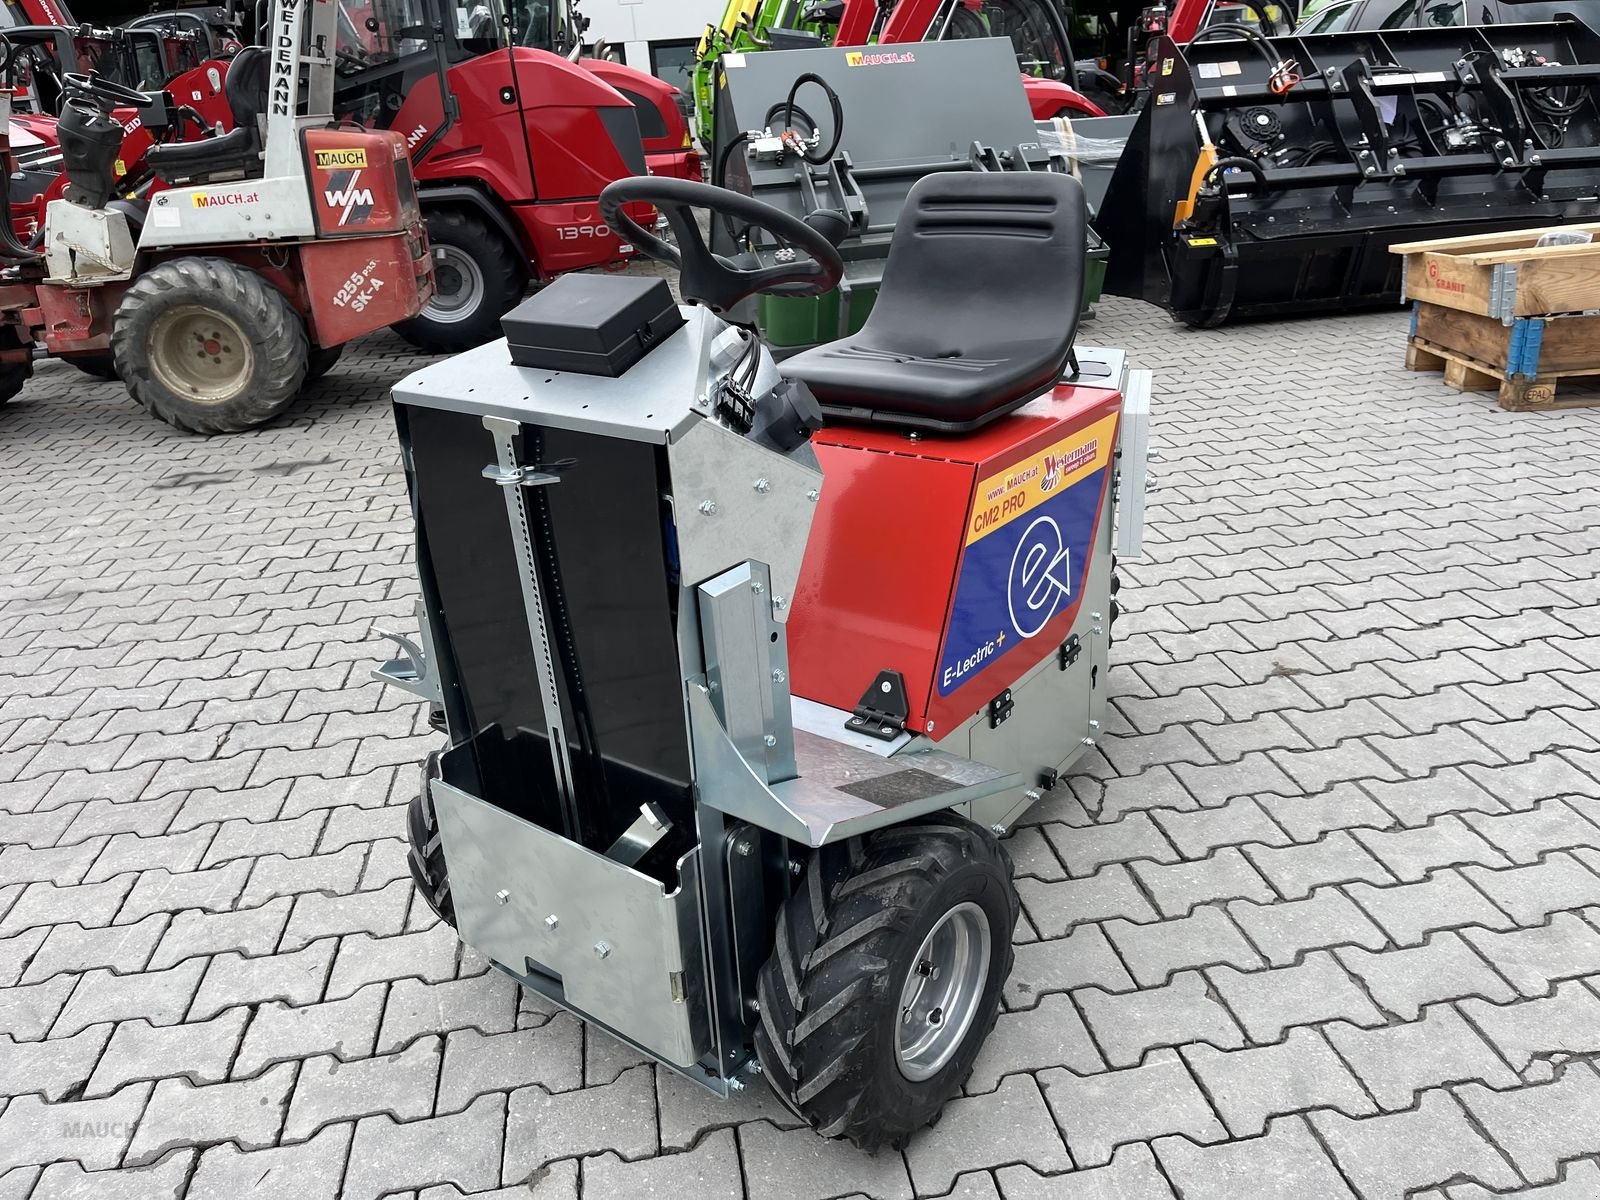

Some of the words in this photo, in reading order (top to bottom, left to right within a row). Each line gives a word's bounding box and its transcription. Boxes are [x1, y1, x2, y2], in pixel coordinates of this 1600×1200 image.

[273, 0, 299, 116] WEIDEMANN
[852, 52, 914, 65] MAUCH.at
[318, 152, 364, 167] MAUCH
[197, 193, 260, 208] MAUCH.at
[556, 224, 611, 240] 1390
[333, 272, 364, 307] 1255
[351, 278, 384, 312] SK-A
[1436, 279, 1465, 293] GRANIT
[1527, 390, 1546, 400] EPAL
[1043, 440, 1097, 478] Westermann
[974, 505, 1000, 533] CM2
[1002, 491, 1026, 519] PRO
[943, 641, 995, 688] E-Lectric
